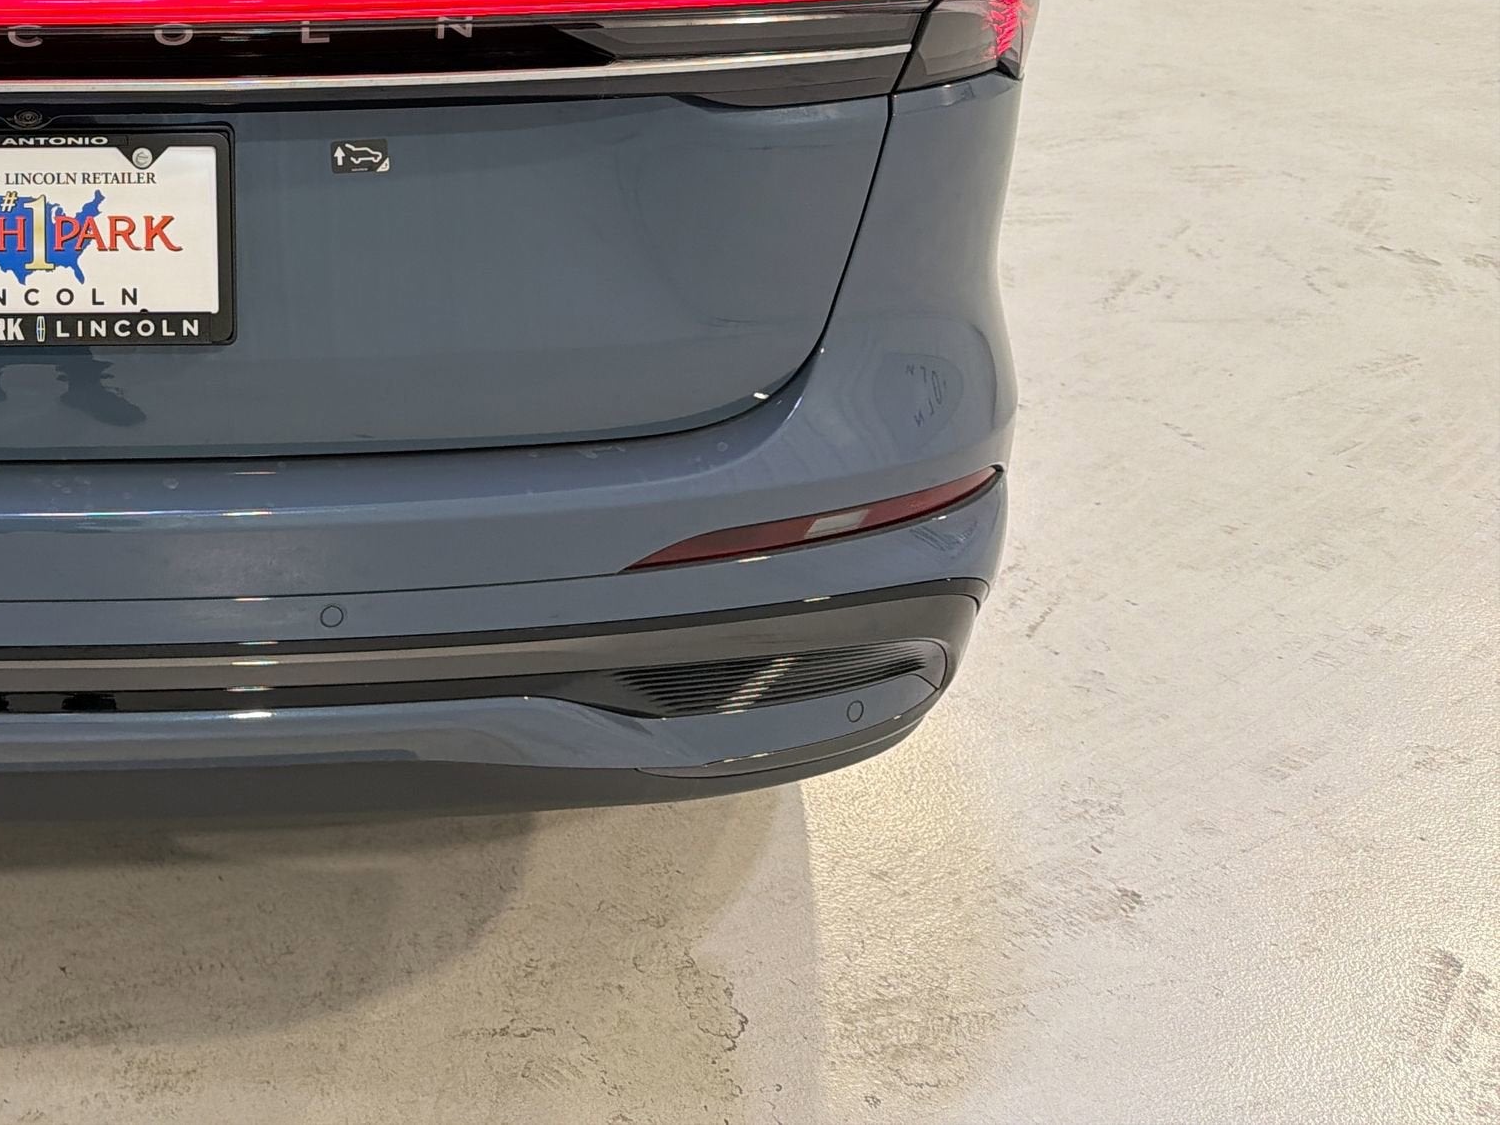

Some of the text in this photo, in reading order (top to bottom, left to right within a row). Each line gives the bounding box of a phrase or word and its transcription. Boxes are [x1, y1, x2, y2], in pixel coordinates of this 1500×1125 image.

[2, 136, 109, 146] ANTONIO
[5, 172, 78, 186] LINCOLN
[82, 172, 157, 185] RETAILER
[53, 215, 182, 252] PARK
[56, 320, 200, 337] LINCOLN
